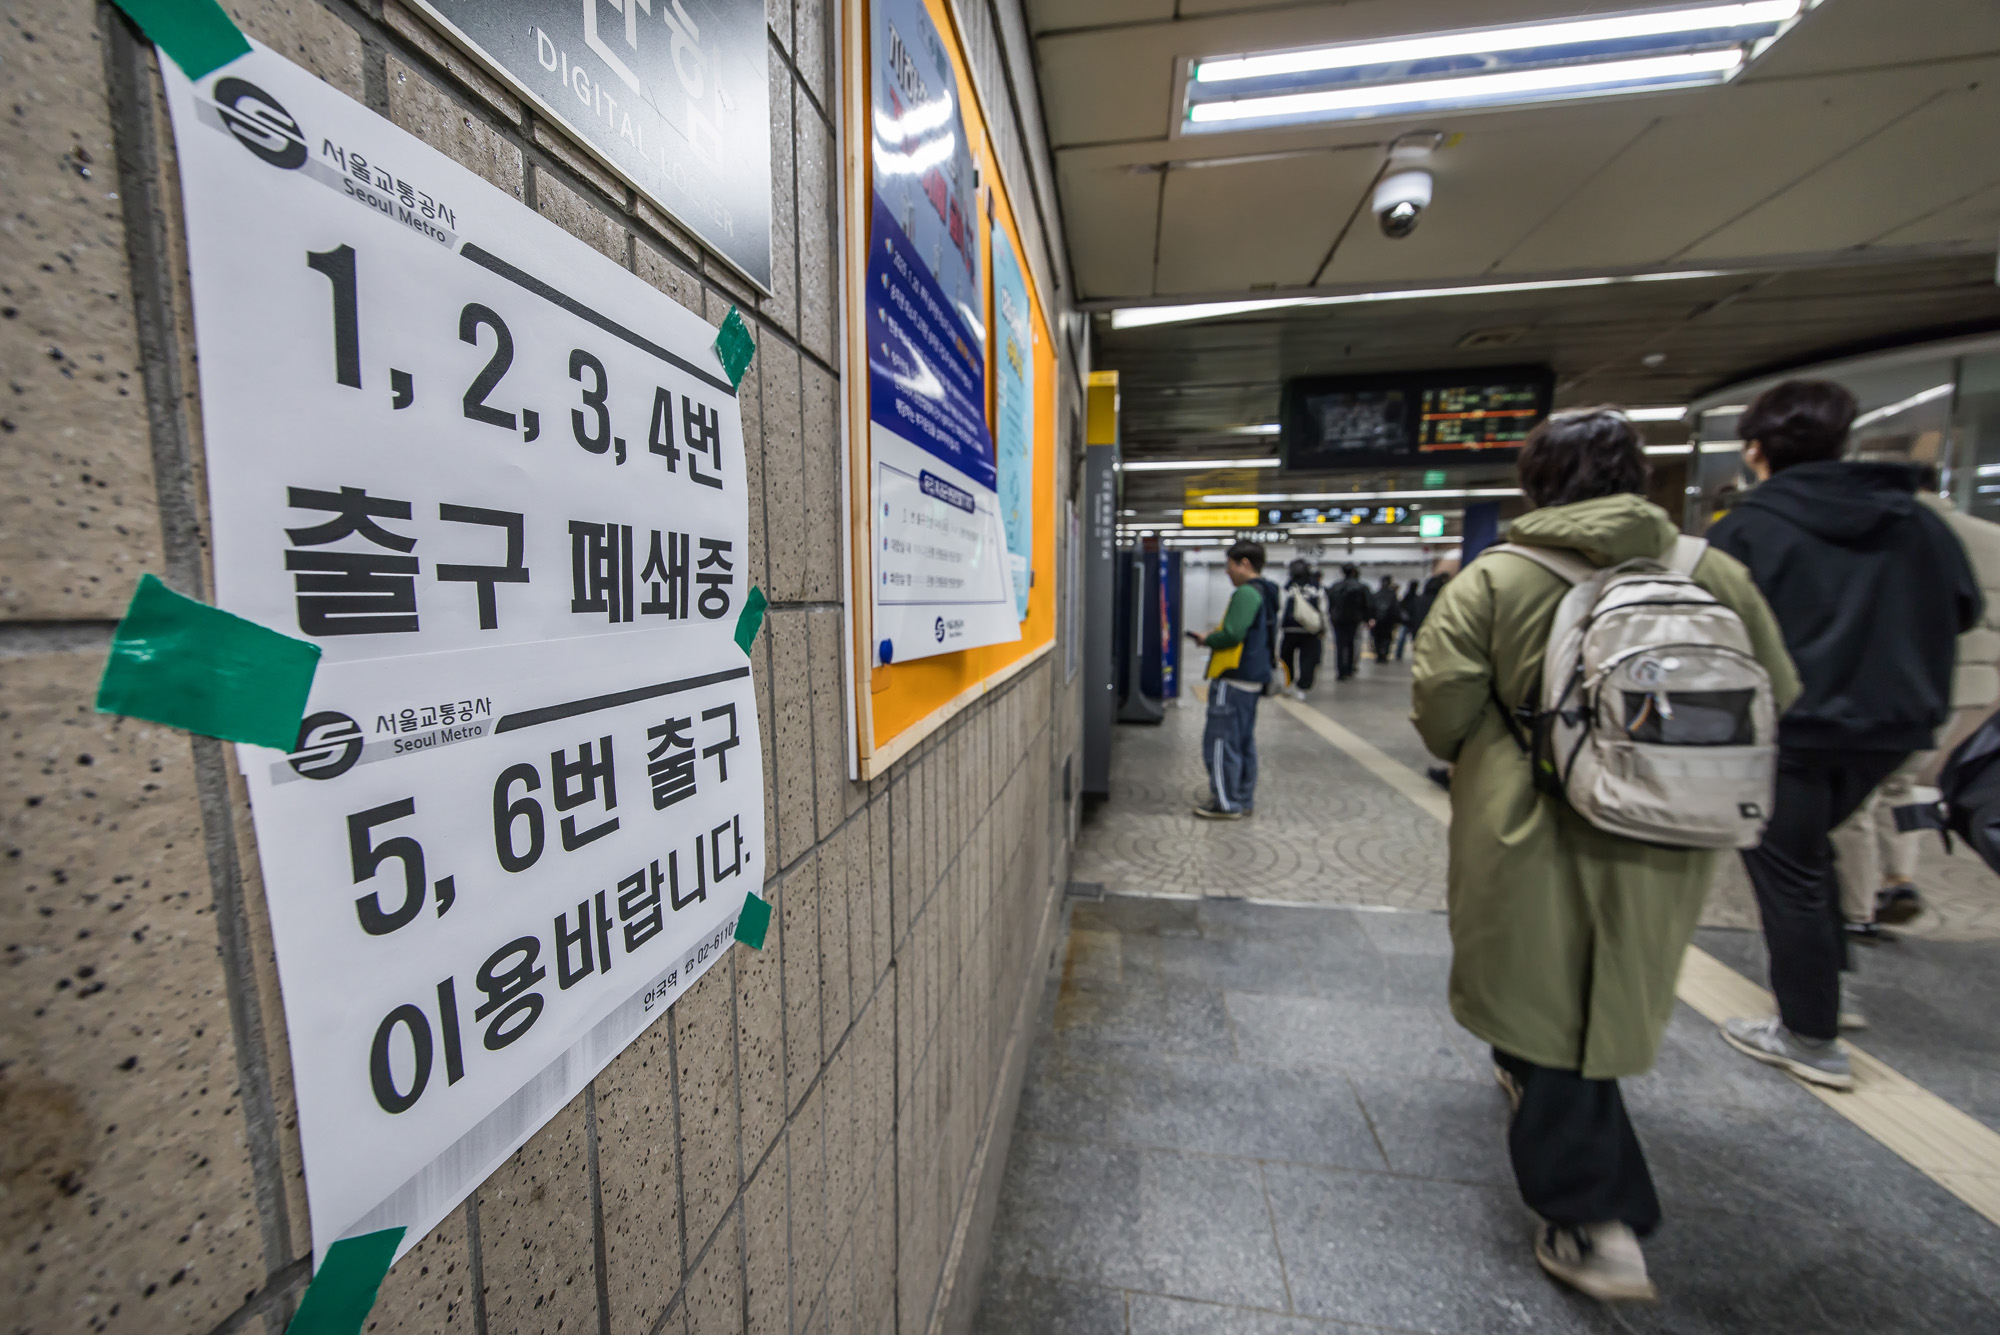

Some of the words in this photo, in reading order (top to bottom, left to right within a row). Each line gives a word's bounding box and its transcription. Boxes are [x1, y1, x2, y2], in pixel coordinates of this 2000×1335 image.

[537, 27, 650, 162] DIGITAL
[322, 138, 457, 231] 서울교통공사
[344, 178, 394, 217] Seoul
[398, 206, 446, 242] Metro
[307, 243, 414, 410] 1,
[459, 302, 540, 443] 2,
[568, 348, 627, 466] 3,
[648, 385, 723, 491] 4번
[284, 485, 530, 637] 출구
[568, 519, 734, 624] 폐쇄중
[376, 697, 492, 735] 서울교통공사
[394, 732, 436, 754] Seoul
[441, 726, 482, 744] Metro
[346, 796, 456, 936] 5,
[493, 735, 620, 873] 6번
[646, 702, 740, 812] 출구
[369, 814, 752, 1115] 이용바랍니다.
[644, 969, 678, 1013] 안국역
